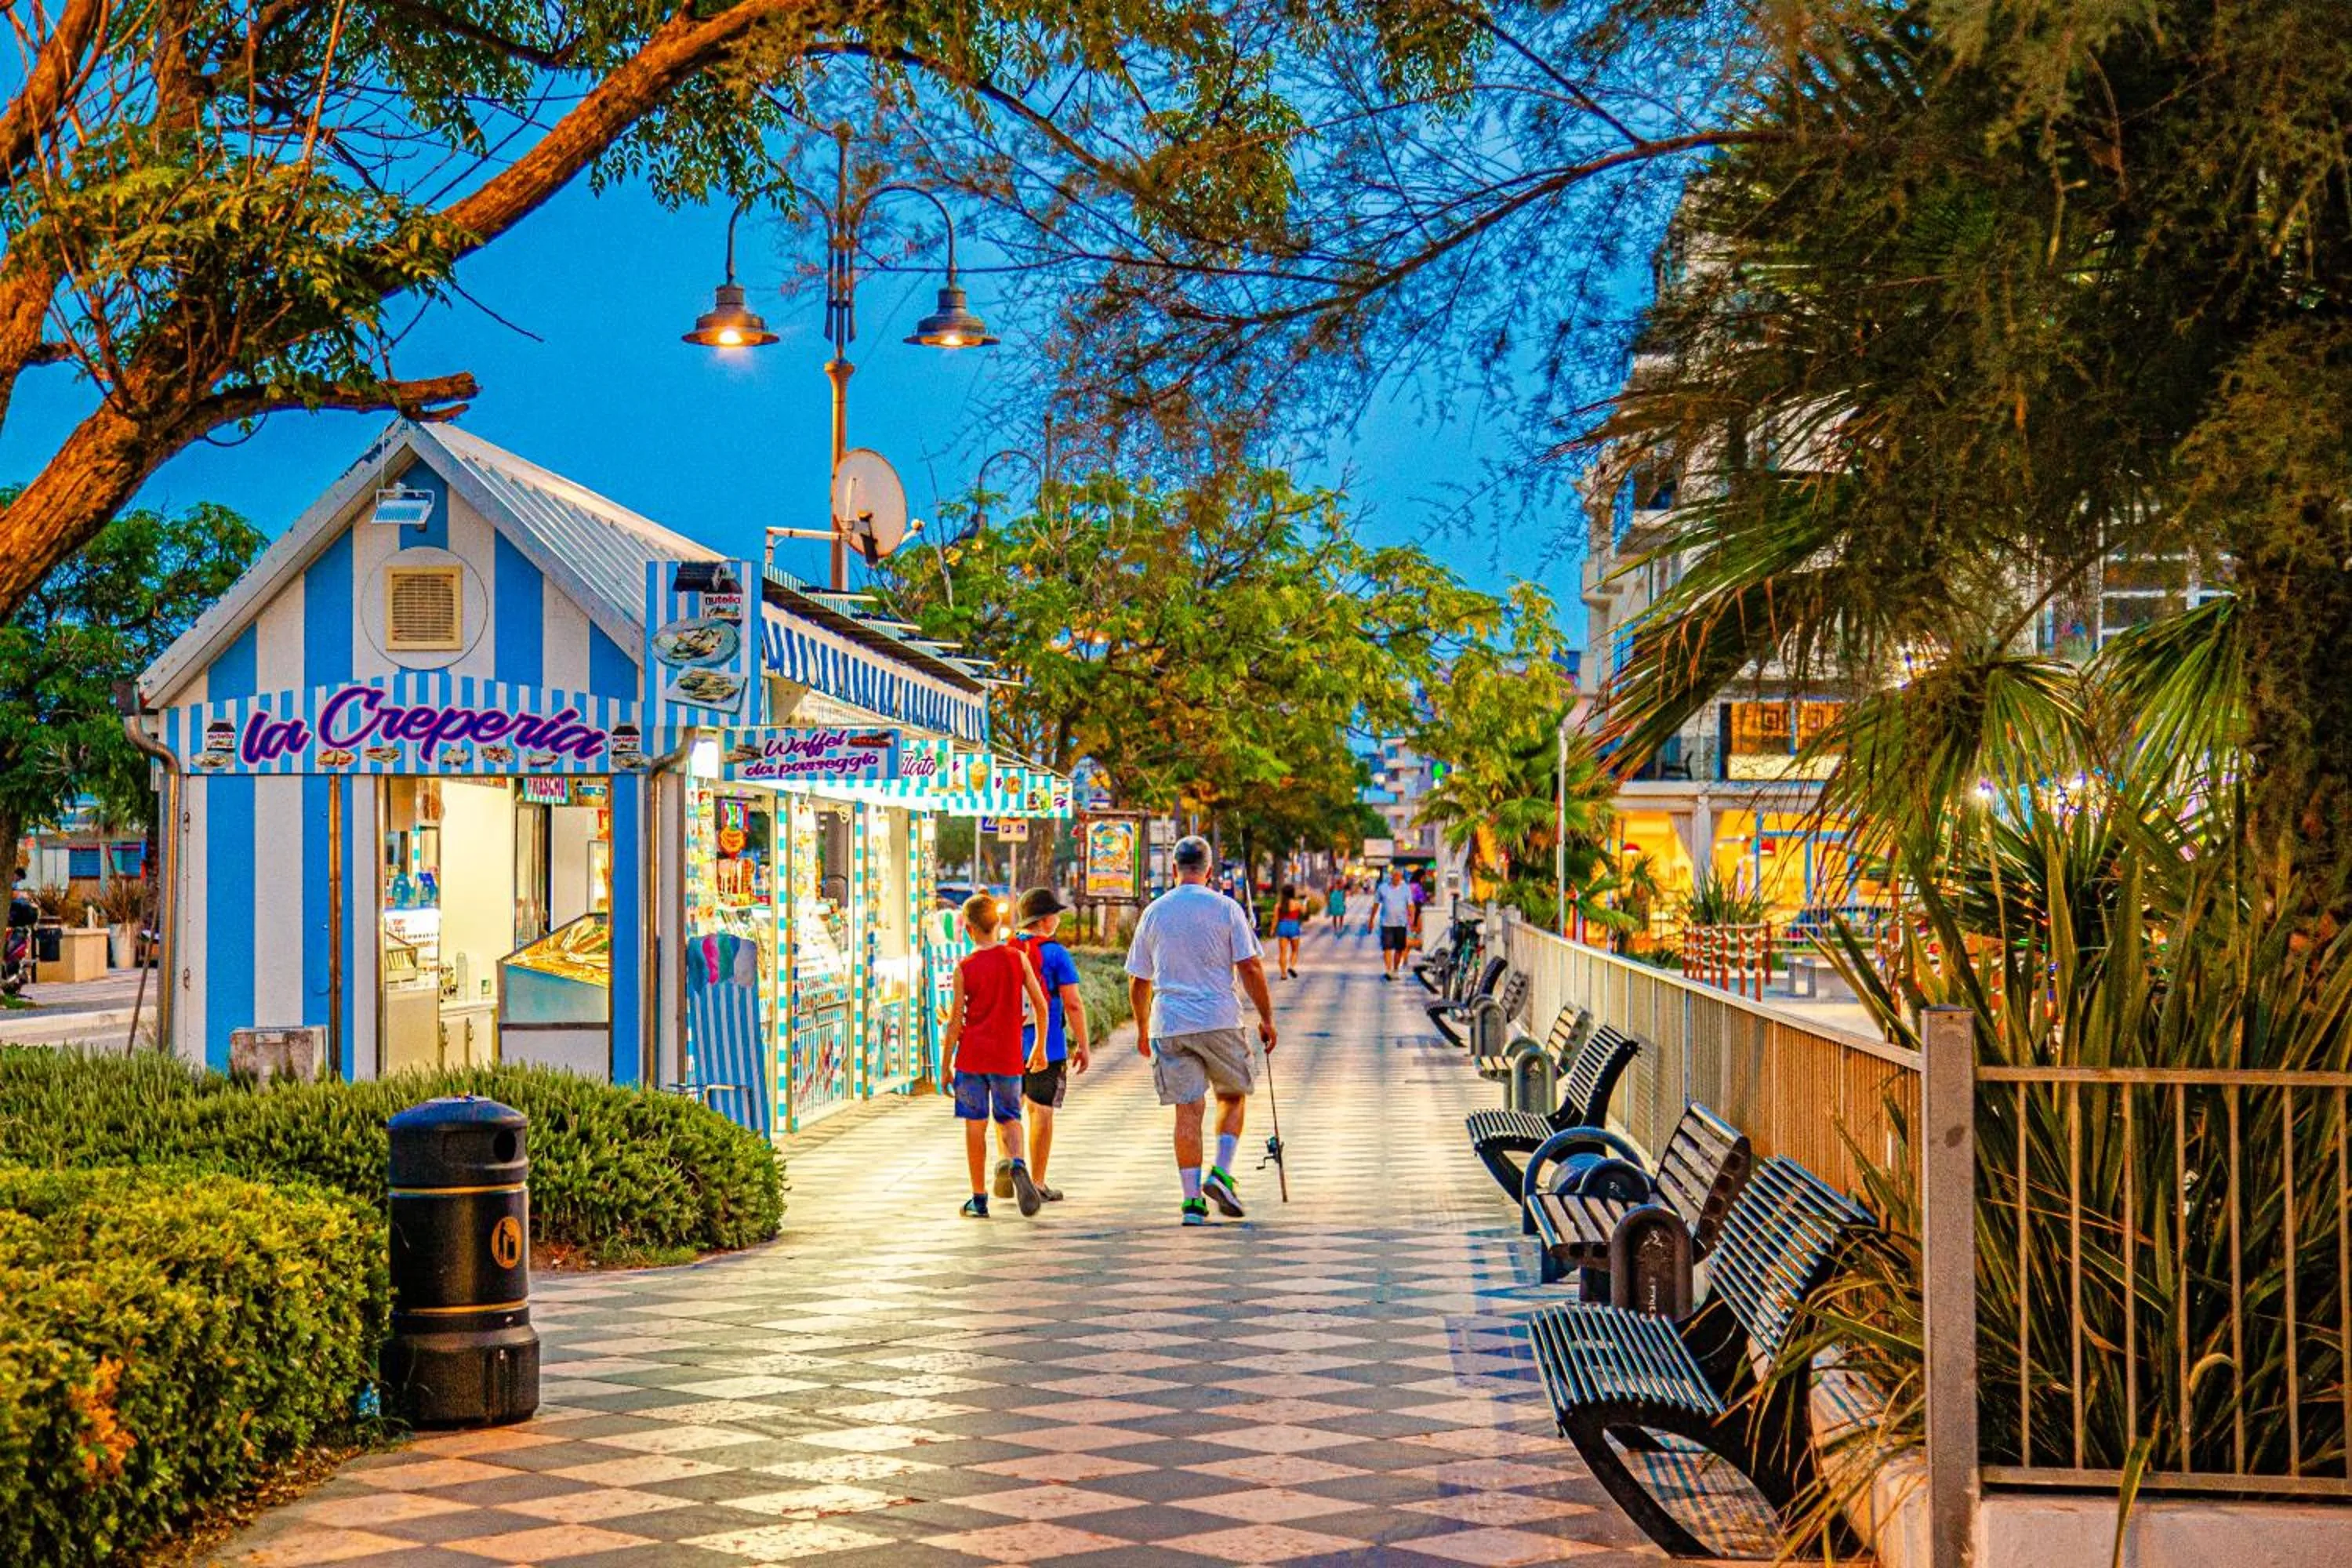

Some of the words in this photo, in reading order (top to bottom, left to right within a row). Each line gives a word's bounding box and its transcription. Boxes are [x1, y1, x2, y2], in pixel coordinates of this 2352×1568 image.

[705, 593, 741, 606] nutella
[241, 711, 311, 764] la
[764, 730, 848, 758] Waffel
[745, 761, 775, 776] da
